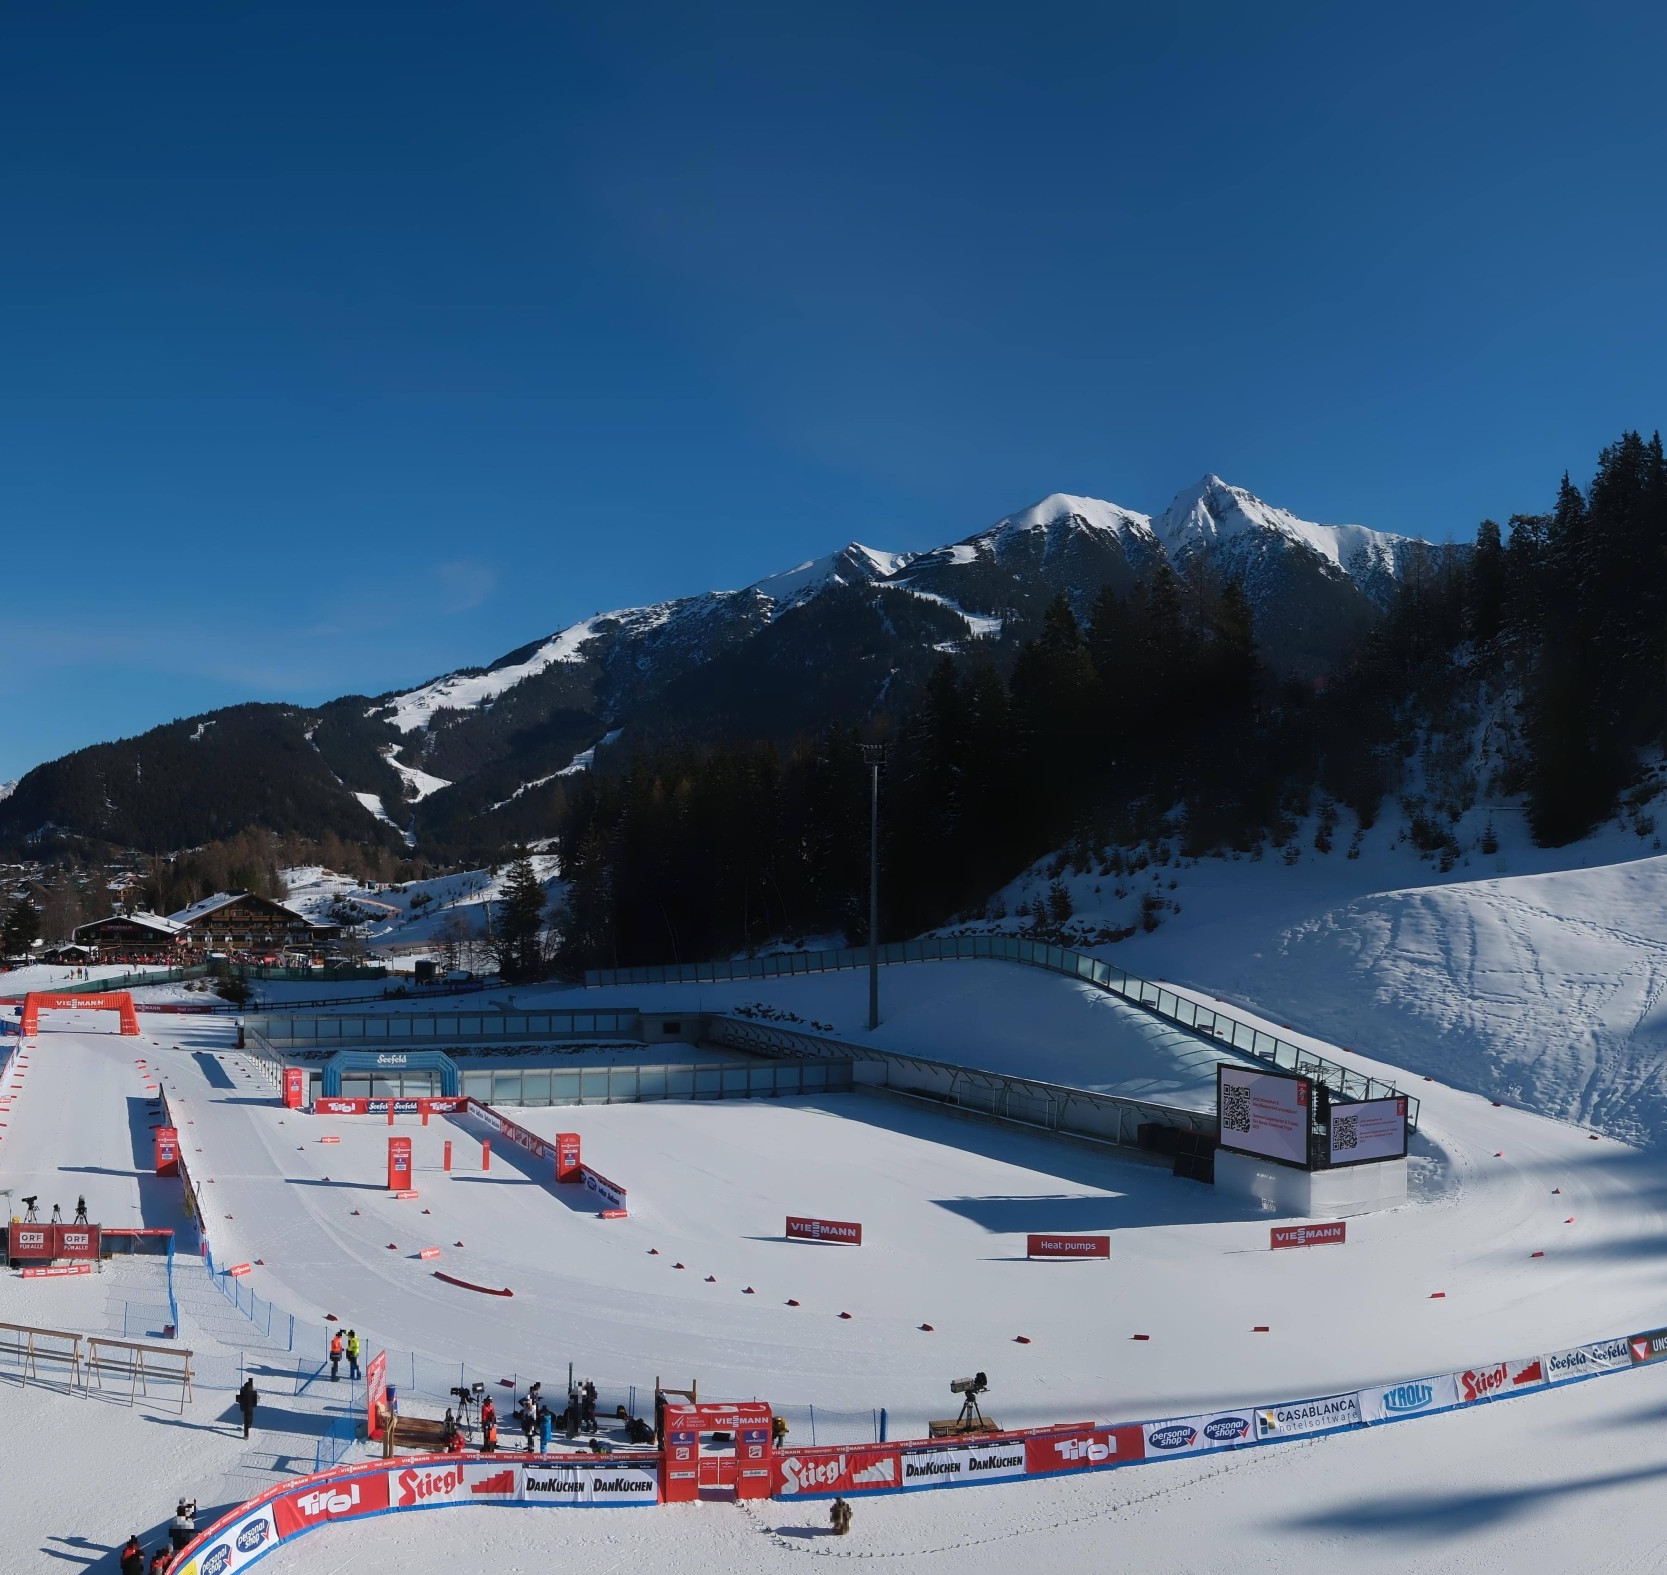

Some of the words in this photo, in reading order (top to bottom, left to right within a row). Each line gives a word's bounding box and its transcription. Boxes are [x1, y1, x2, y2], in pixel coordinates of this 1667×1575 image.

[56, 998, 104, 1009] VIESSMANN
[377, 1055, 407, 1065] Seefeld
[328, 1102, 356, 1112] Tirol
[369, 1101, 388, 1111] Seefel
[394, 1101, 417, 1111] Seefeld
[790, 1221, 856, 1237] VIESSMANN
[1275, 1228, 1341, 1244] VIESSMANN
[21, 1234, 43, 1242] ORF
[66, 1235, 87, 1243] ORF
[1041, 1241, 1062, 1249] Heat
[1065, 1243, 1097, 1252] pumps
[1591, 1343, 1628, 1362] Seefeld
[1549, 1351, 1587, 1371] Seefeld
[1461, 1363, 1508, 1402] Stiegl
[1383, 1384, 1432, 1409] TYROLIT
[1277, 1399, 1356, 1423] CASABLANCA
[714, 1415, 769, 1427] VIESSMANN
[1206, 1419, 1245, 1435] personal
[1279, 1410, 1357, 1432] hotelsoftware
[1151, 1428, 1191, 1444] personal
[1215, 1428, 1235, 1438] shop
[1054, 1435, 1116, 1461] Tirol
[1160, 1436, 1182, 1447] shop
[772, 1449, 801, 1457] VIESSMANN
[340, 1464, 368, 1474] VIESSMANN
[402, 1456, 430, 1465] VIESSMANN
[781, 1454, 848, 1494] Stiegl
[398, 1464, 464, 1507] Stiegl
[297, 1484, 361, 1516] Tirol
[237, 1521, 265, 1547] personal
[245, 1533, 260, 1549] shop
